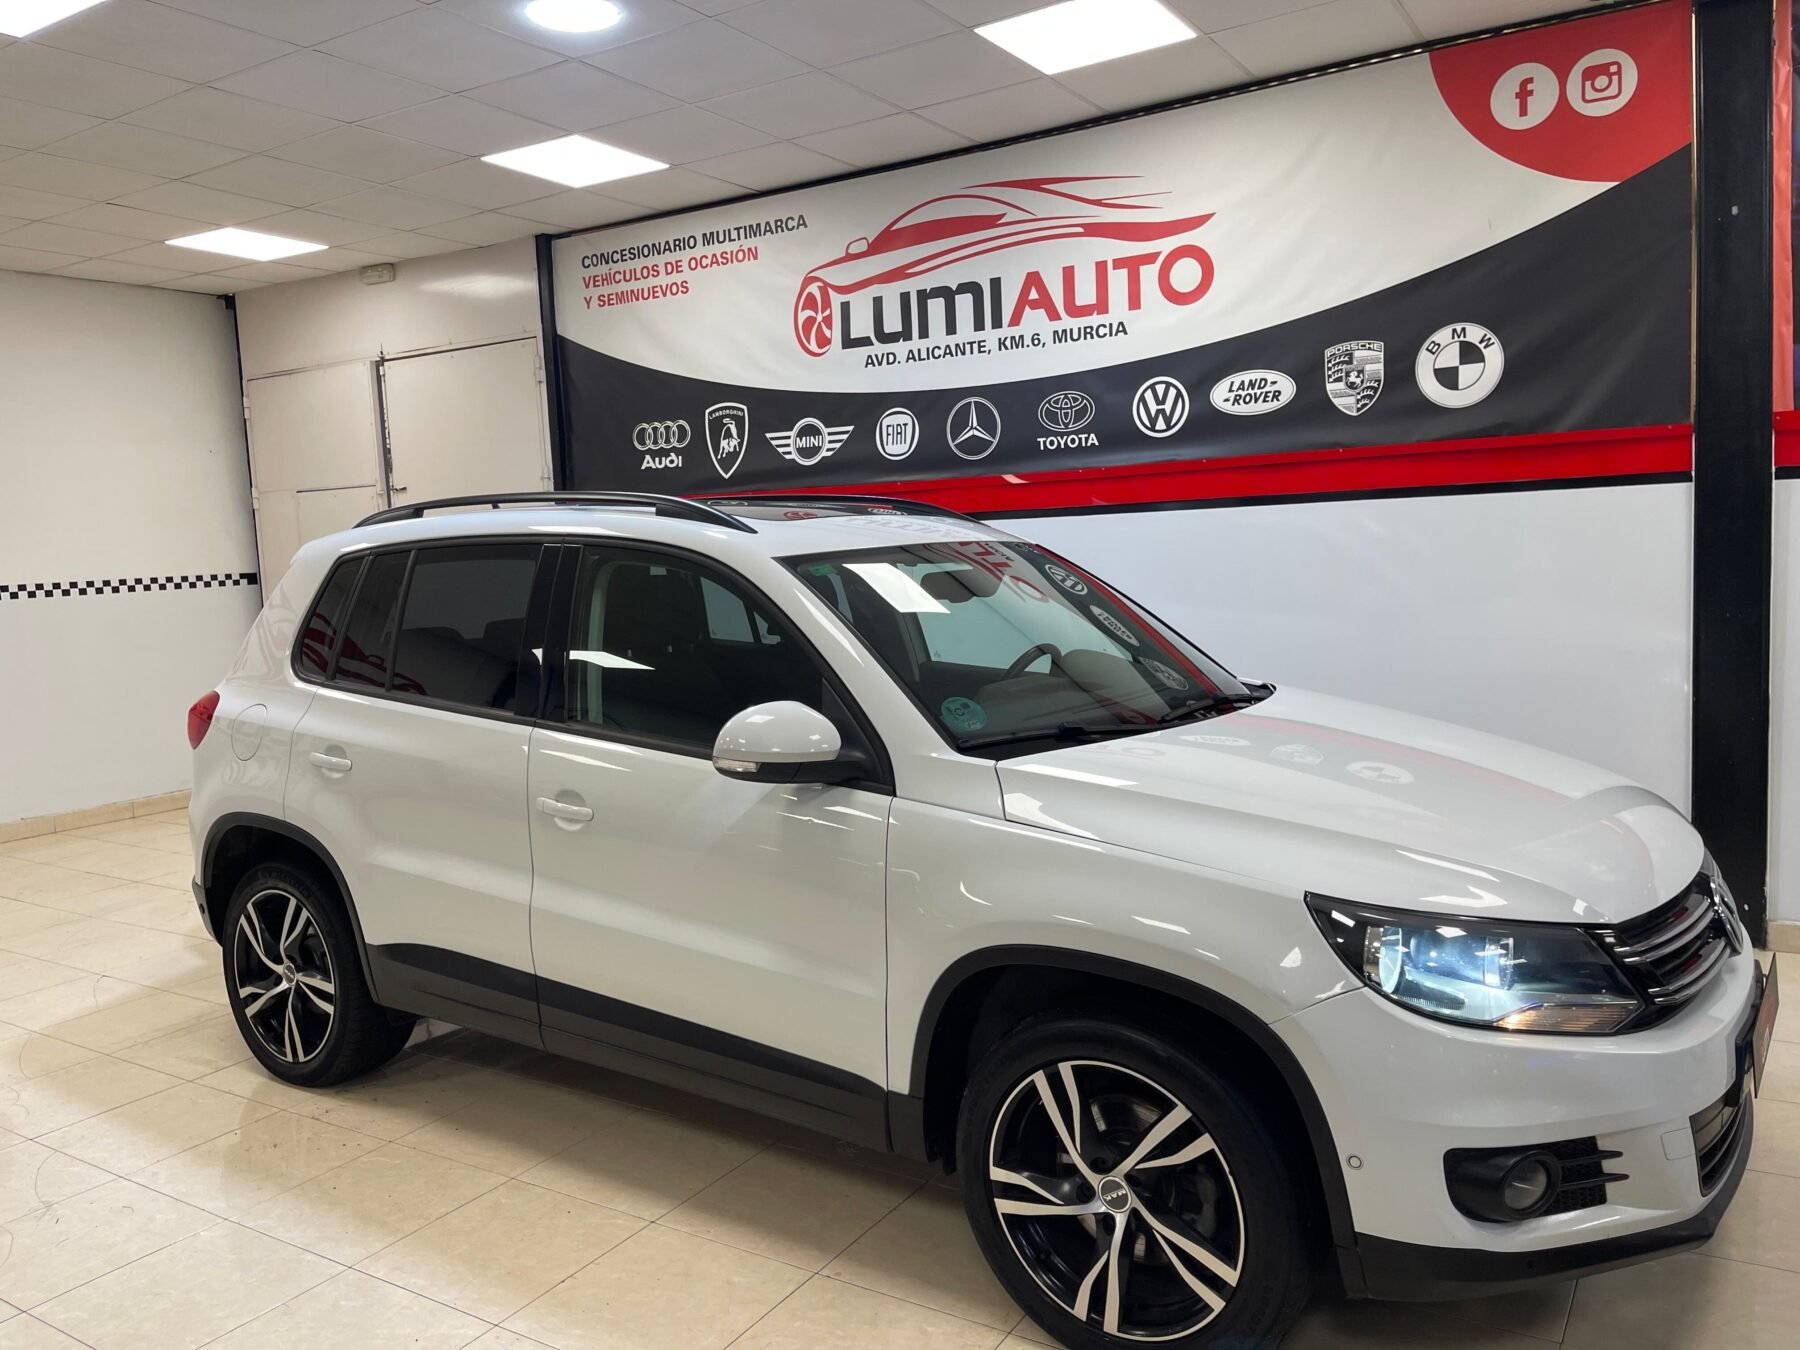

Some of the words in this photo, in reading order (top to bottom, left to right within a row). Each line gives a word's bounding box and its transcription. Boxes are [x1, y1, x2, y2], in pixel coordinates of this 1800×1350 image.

[581, 235, 698, 269] CONCESIONARIO
[701, 214, 808, 249] MULTIMARCA
[582, 263, 660, 290] VEHÍCULOS
[664, 260, 684, 277] DE
[687, 244, 759, 271] OCASIÓN
[583, 295, 593, 310] Y
[597, 280, 690, 308] SEMINUEVOS
[864, 350, 902, 369] AVD.
[905, 339, 993, 364] ALICANTE,
[1052, 320, 1128, 346] MURCIA
[1327, 342, 1382, 358] PORSCHE
[795, 435, 823, 449] MINI
[886, 422, 909, 447] FIAT
[1036, 433, 1099, 451] TOYOTA
[641, 454, 682, 470] Audi
